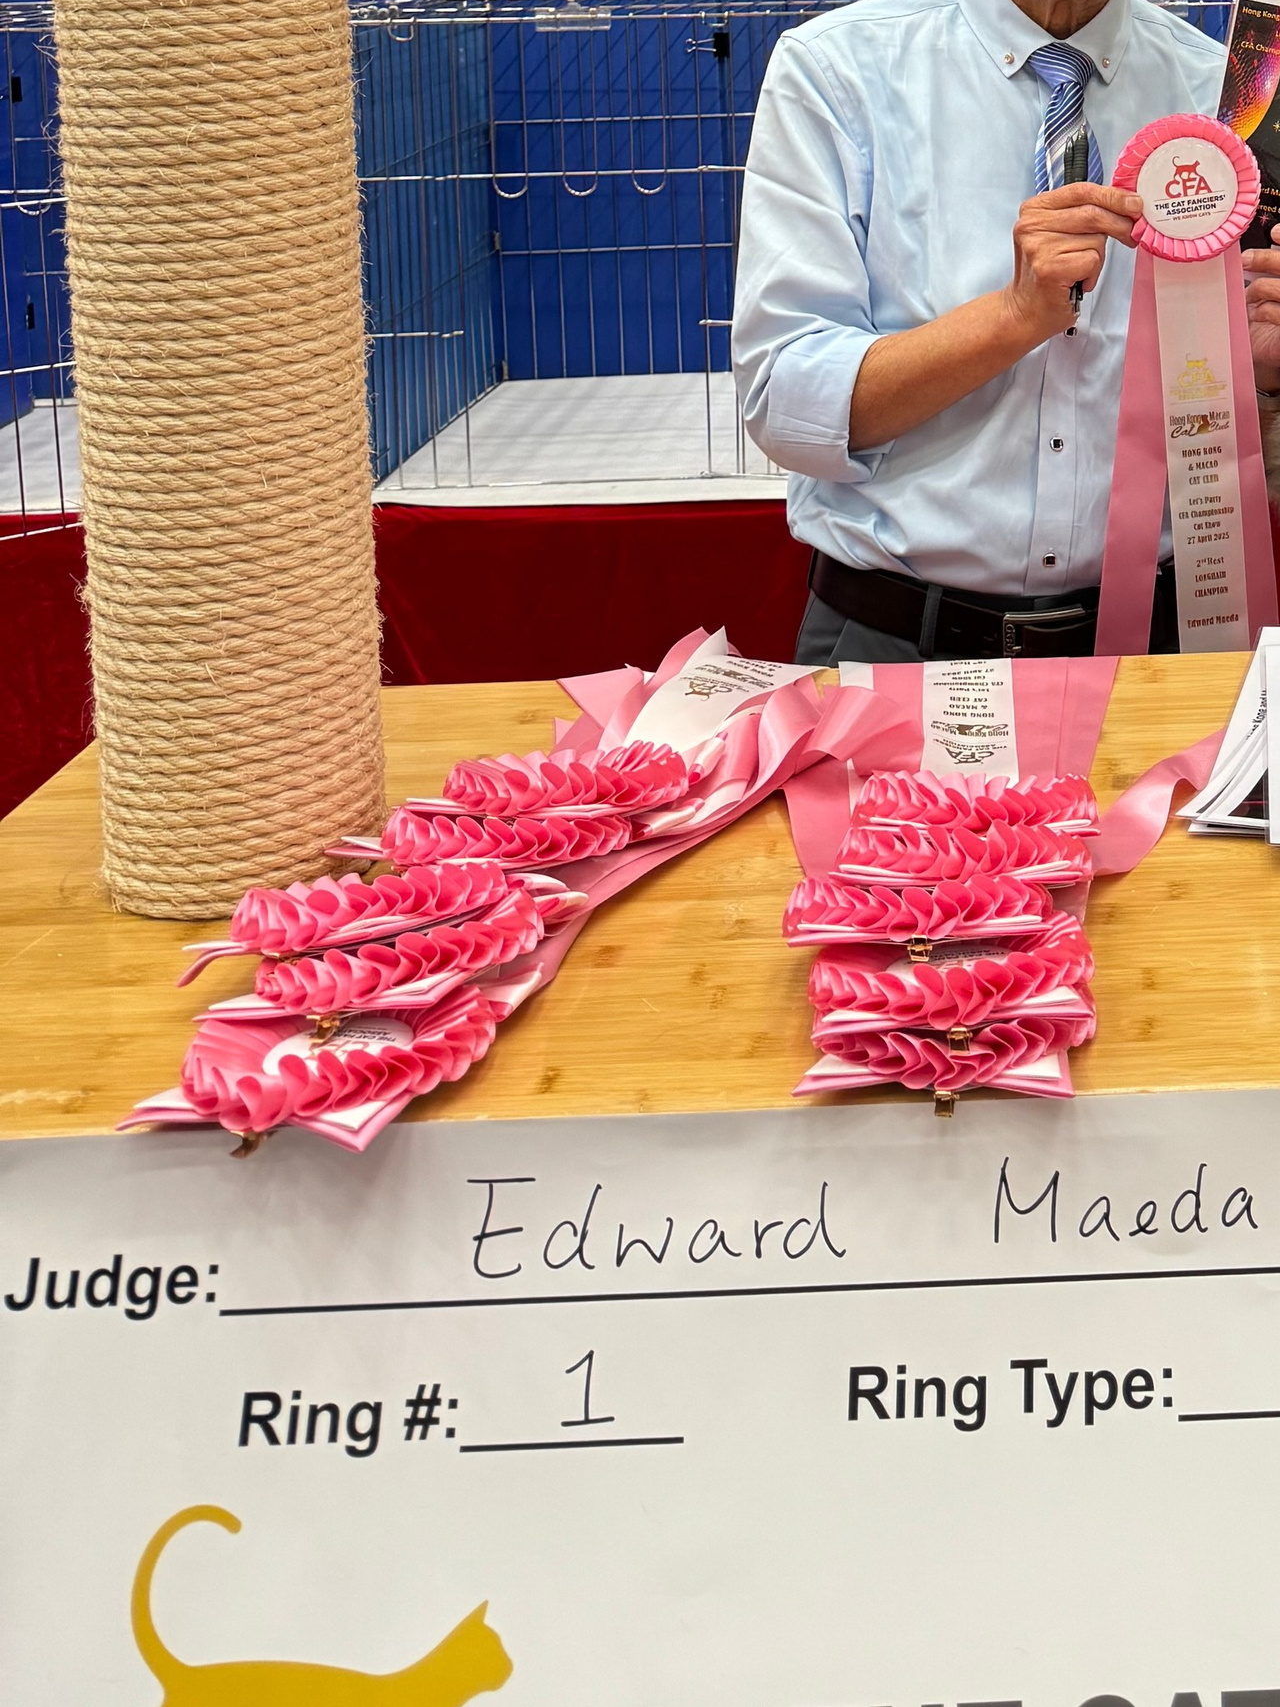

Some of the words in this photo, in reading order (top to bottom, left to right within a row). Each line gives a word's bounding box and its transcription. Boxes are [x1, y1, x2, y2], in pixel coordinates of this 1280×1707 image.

[1242, 6, 1261, 17] Hong
[1263, 11, 1280, 21] Kong
[1241, 41, 1255, 49] CFA
[1165, 176, 1212, 198] CFA
[1187, 195, 1225, 205] FANCIERS'
[1167, 203, 1216, 215] ASSOCIATION
[1182, 448, 1201, 457] HONG
[1203, 446, 1222, 455] KONG
[1196, 460, 1218, 470] MACAO
[1189, 476, 1200, 485] CAT
[1187, 537, 1195, 545] 27
[1195, 586, 1228, 598] CHAMPION
[1188, 617, 1214, 628] Edward
[945, 748, 995, 758] CFA
[4, 1255, 222, 1320] Judge:
[468, 1176, 847, 1280] Edward
[992, 1156, 1259, 1245] Maeda
[847, 1363, 988, 1432] Ring
[1009, 1358, 1177, 1428] Type:
[238, 1389, 383, 1459] Ring
[402, 1384, 459, 1442] #:
[560, 1349, 615, 1428] 1
